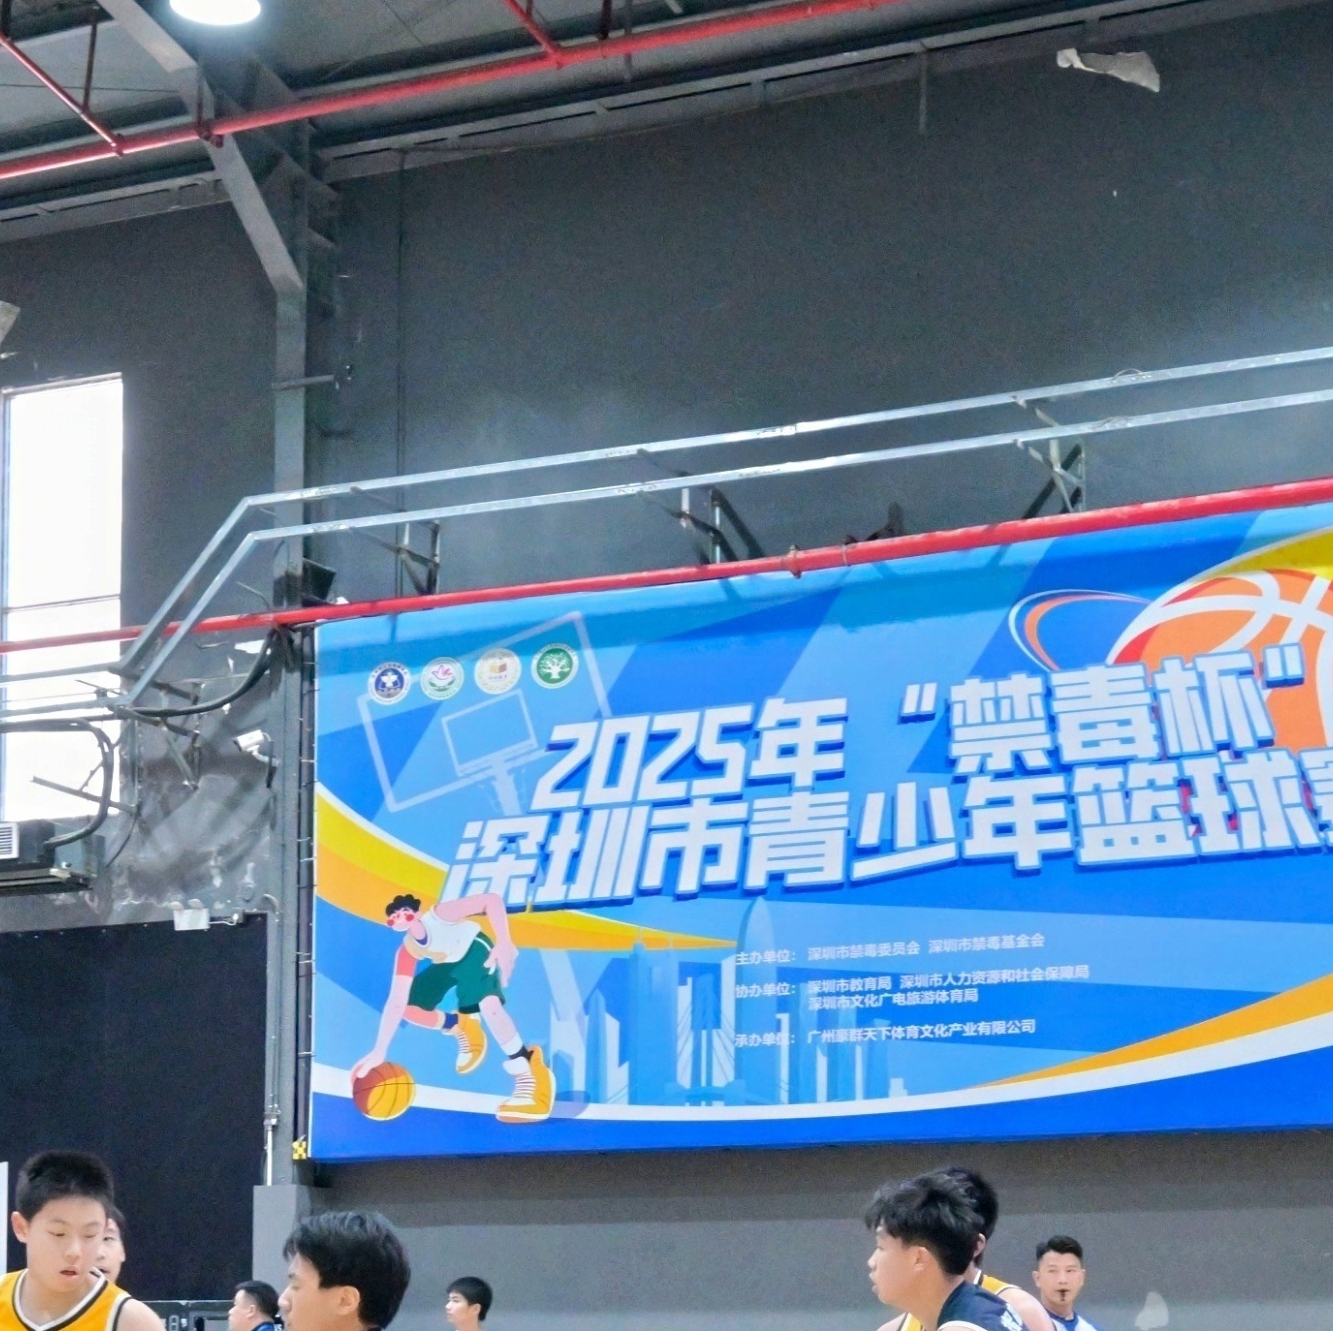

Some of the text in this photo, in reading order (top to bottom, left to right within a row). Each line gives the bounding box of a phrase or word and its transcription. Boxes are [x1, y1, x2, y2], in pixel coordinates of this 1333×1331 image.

[530, 698, 849, 811] 2025年
[808, 940, 920, 961] 深圳市禁毒委员会
[928, 932, 1045, 954] 深圳市禁毒基金会
[807, 975, 892, 994] 深圳市教育局
[899, 964, 1090, 989] 深圳市人力资源和社会保障局
[808, 988, 979, 1011] 深圳市文化广电旅游体育局
